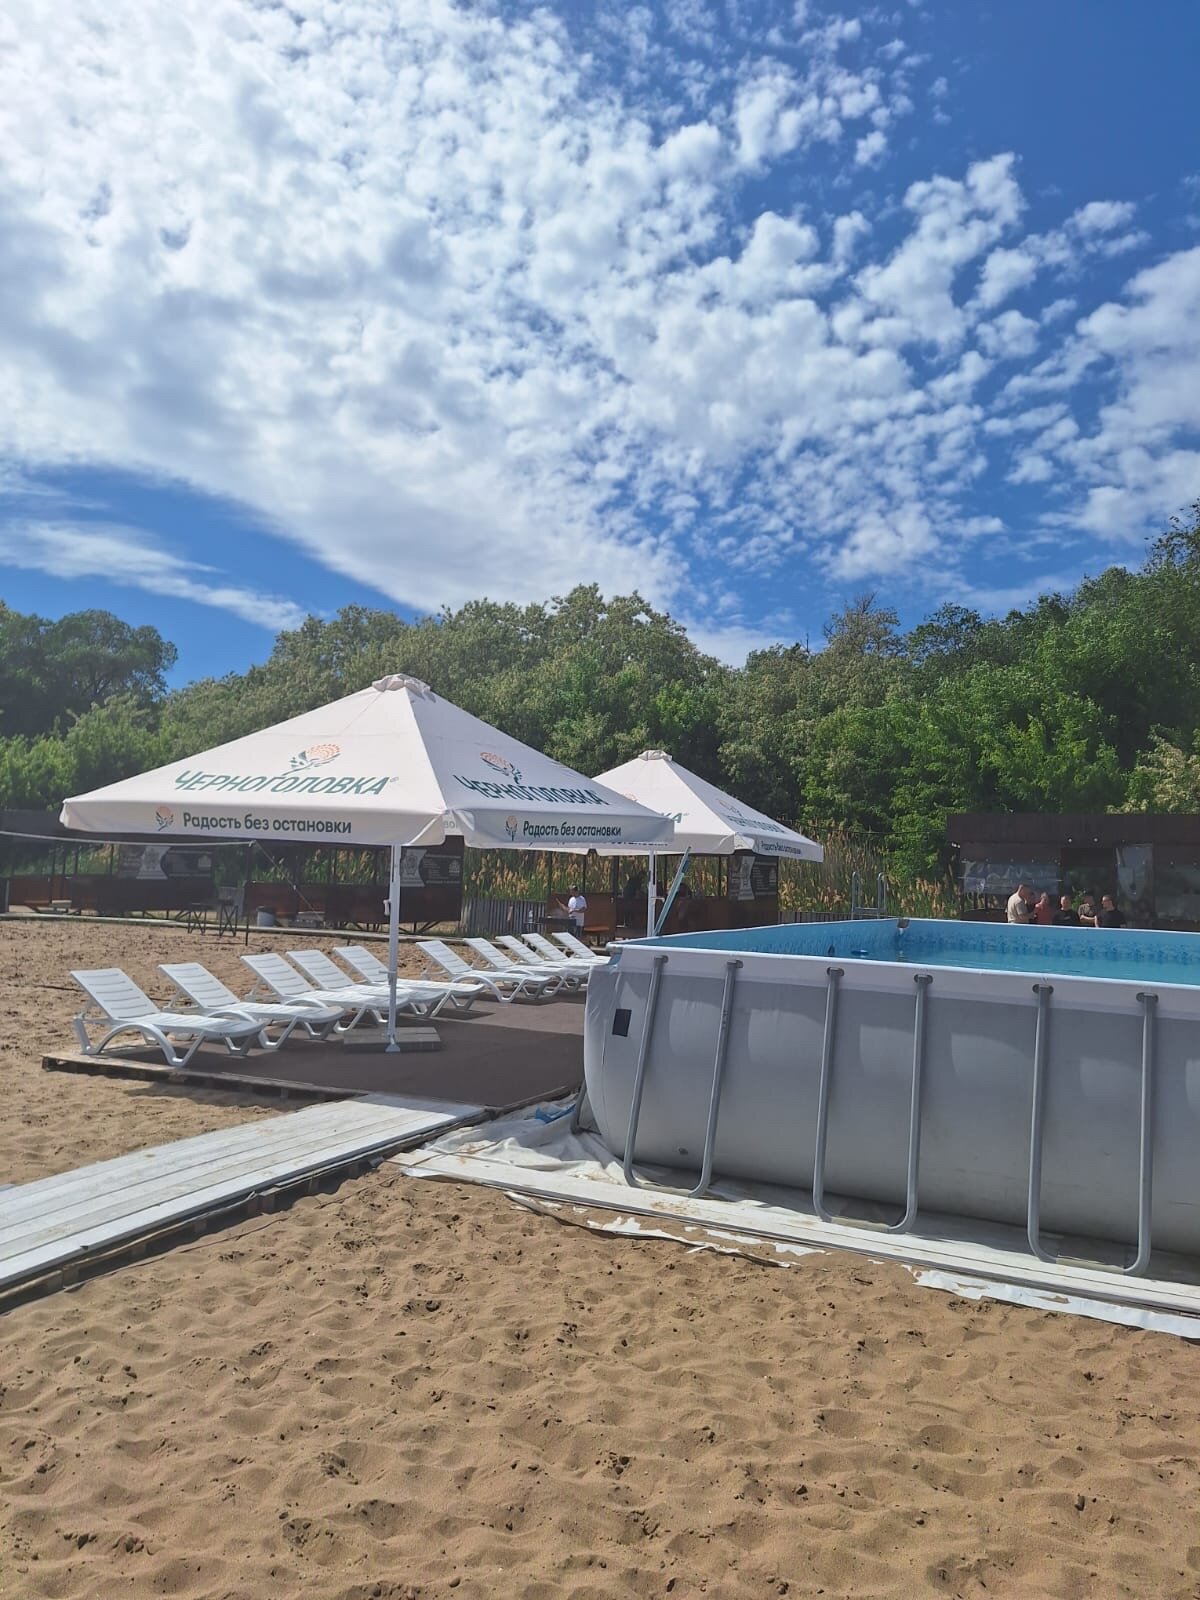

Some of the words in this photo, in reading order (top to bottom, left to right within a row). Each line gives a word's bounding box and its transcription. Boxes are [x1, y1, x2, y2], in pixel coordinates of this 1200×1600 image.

[175, 771, 390, 794] ЧЕРНОГОЛОВКА
[453, 775, 611, 805] ЧЕРНОГОЛОВКА
[183, 812, 241, 830] Радость
[244, 814, 270, 830] без
[273, 819, 352, 834] остановки
[523, 821, 558, 836] Радость
[560, 822, 575, 835] без
[577, 825, 622, 836] остановки
